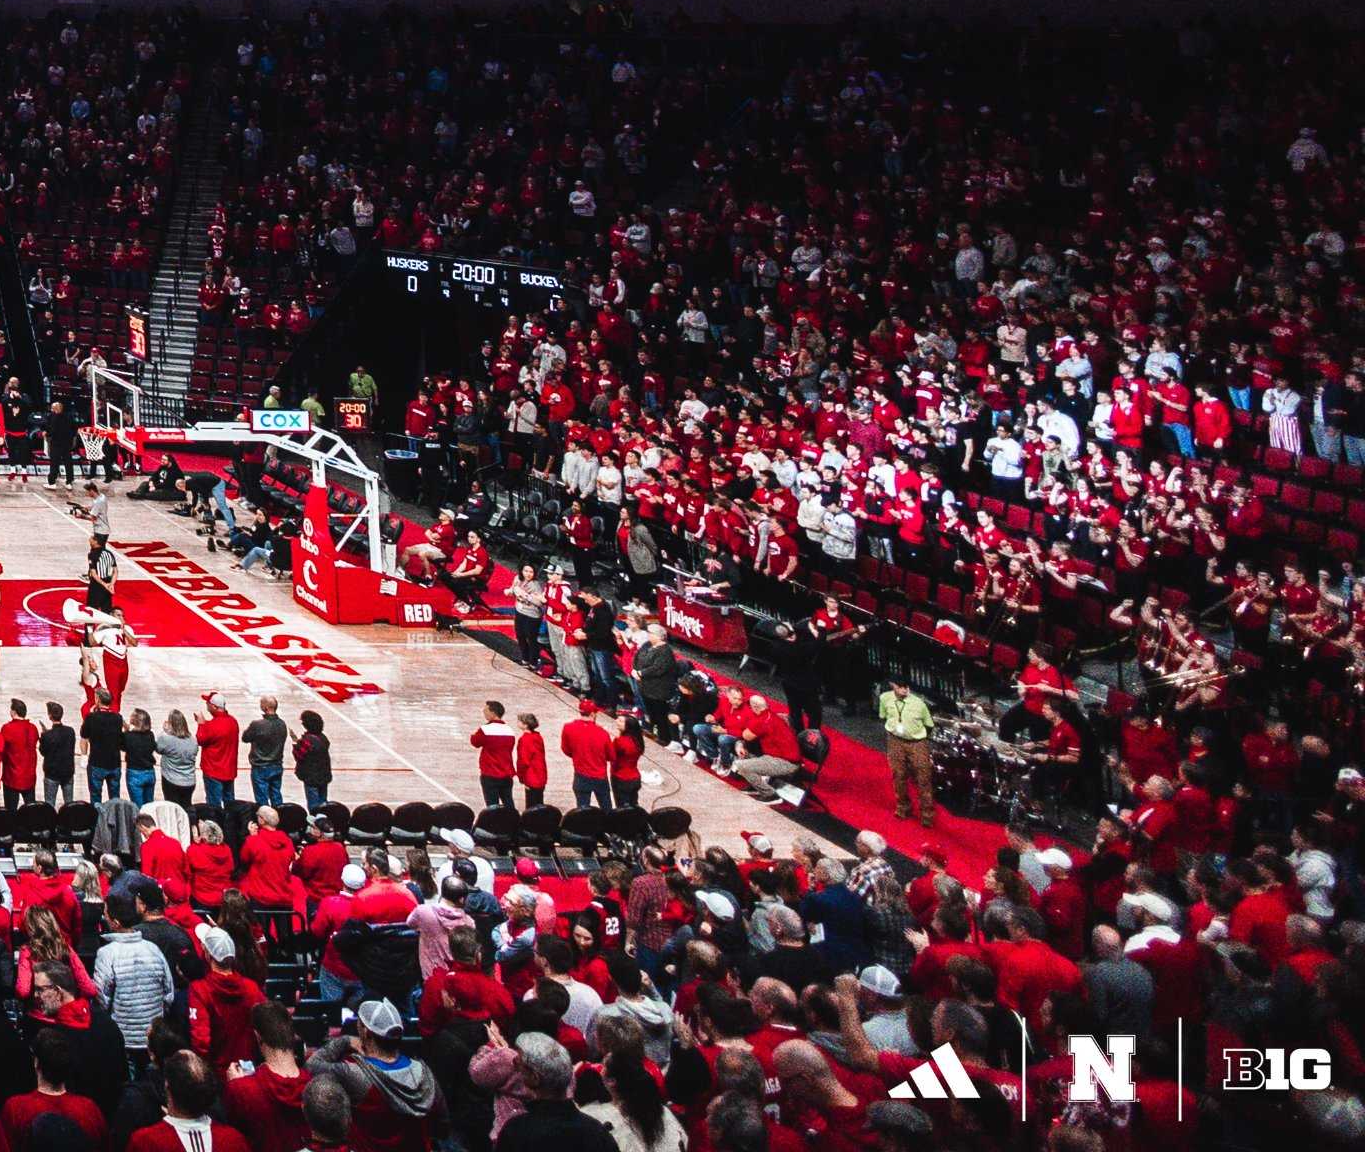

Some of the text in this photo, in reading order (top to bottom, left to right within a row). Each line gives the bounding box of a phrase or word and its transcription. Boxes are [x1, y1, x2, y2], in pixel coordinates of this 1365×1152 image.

[387, 257, 428, 271] HUSKERS
[453, 262, 496, 284] 20:00
[339, 402, 367, 413] 20:00
[260, 413, 302, 428] COX
[345, 414, 362, 428] 30
[300, 532, 320, 556] fnbo
[295, 584, 327, 614] Channel
[107, 540, 386, 703] NEBRASKA
[404, 604, 432, 622] RED
[663, 595, 705, 638] Huskers
